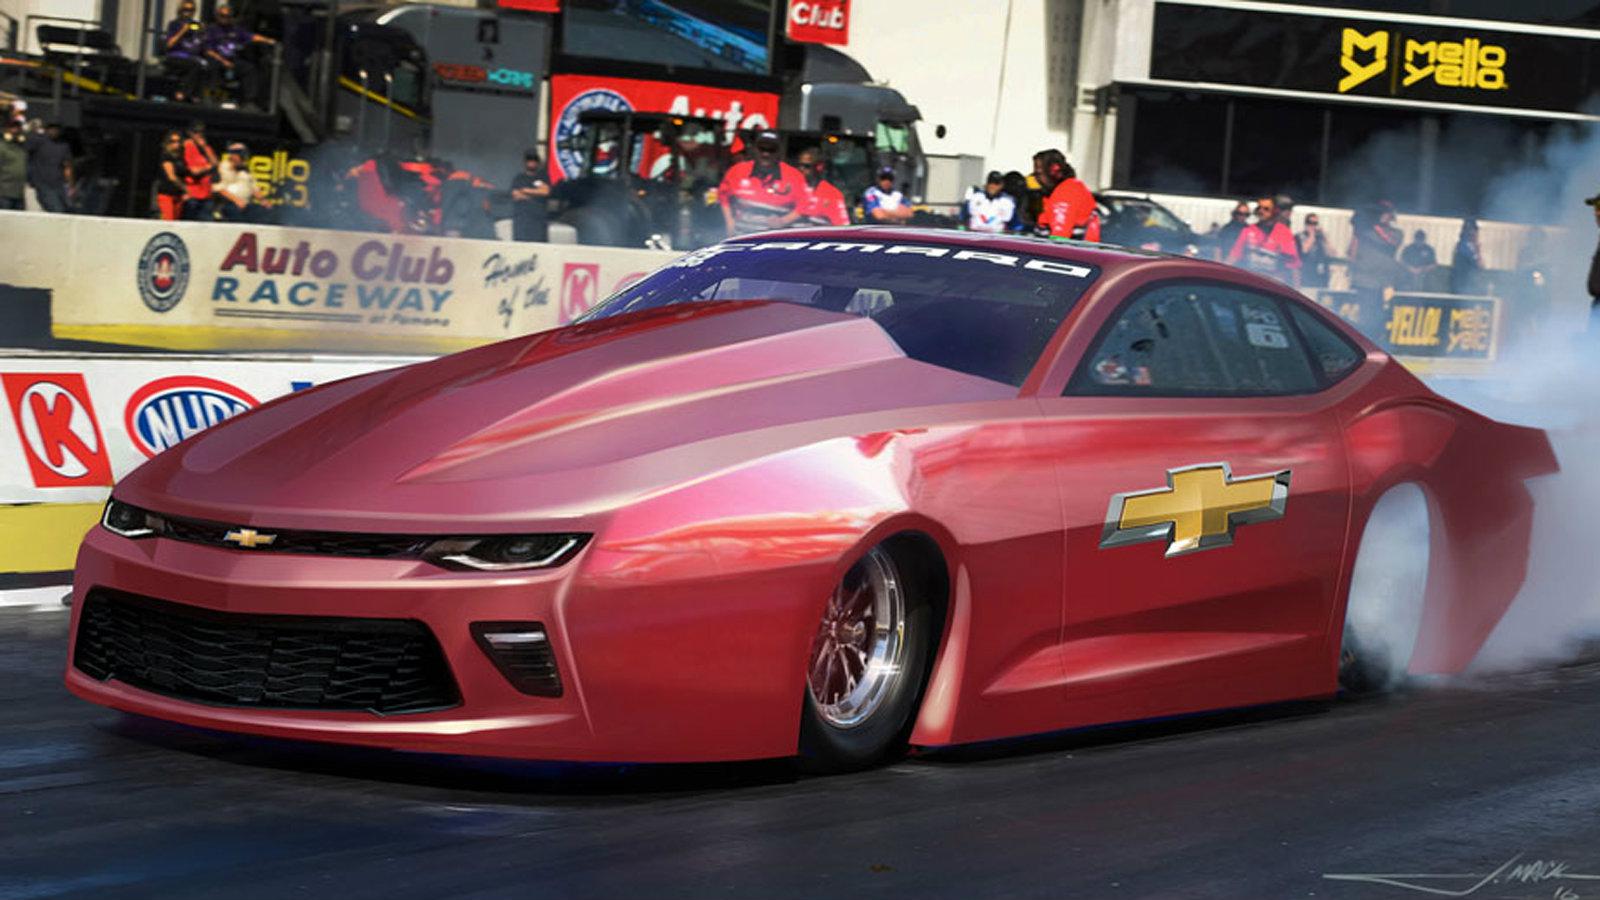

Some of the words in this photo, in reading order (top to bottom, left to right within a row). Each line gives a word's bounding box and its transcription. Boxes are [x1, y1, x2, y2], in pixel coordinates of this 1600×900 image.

[791, 2, 844, 30] Club
[248, 150, 311, 184] ello
[220, 232, 338, 278] Auto
[352, 240, 455, 285] Club
[716, 241, 1092, 279] CAMARO
[211, 276, 453, 312] RACEWAY
